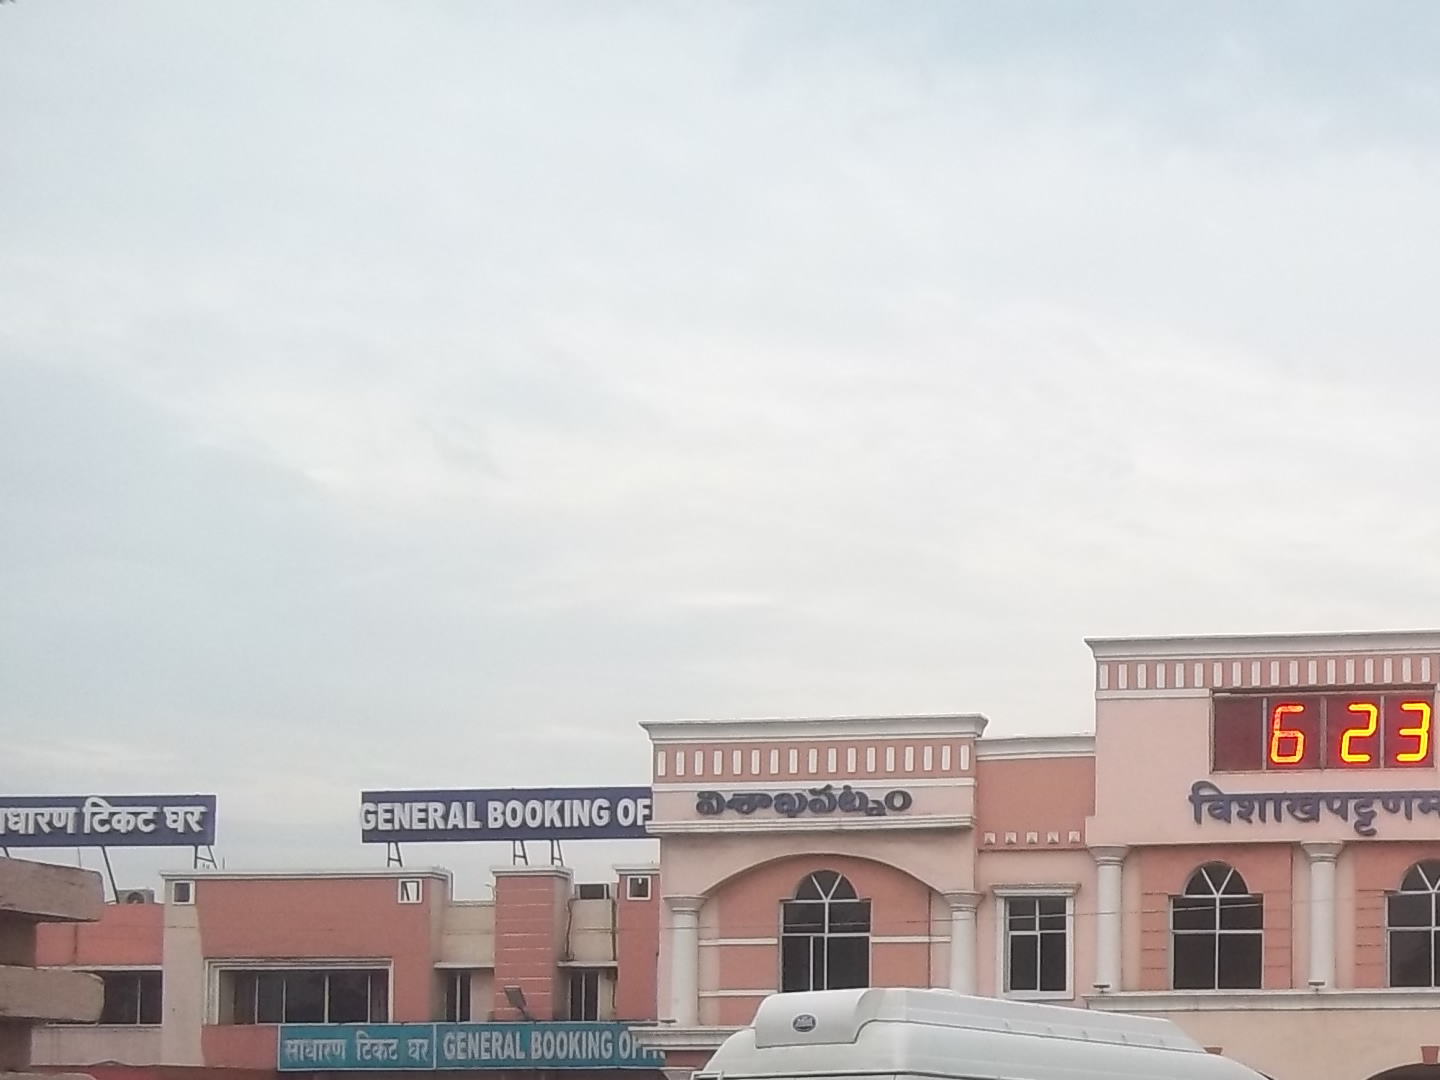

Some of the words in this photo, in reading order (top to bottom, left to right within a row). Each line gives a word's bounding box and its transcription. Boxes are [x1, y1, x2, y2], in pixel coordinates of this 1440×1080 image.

[1270, 702, 1305, 763] 6
[82, 796, 159, 834] टिकट
[163, 806, 208, 834] घर
[360, 801, 482, 831] GENERAL
[487, 798, 611, 829] BOOKING
[696, 784, 913, 818] విశాఖపట్నం
[284, 1038, 347, 1062] साधारण
[356, 1029, 399, 1061] टिकट
[407, 1038, 430, 1061] घर
[443, 1031, 527, 1061] GENERAL
[530, 1031, 614, 1060] BOOKING
